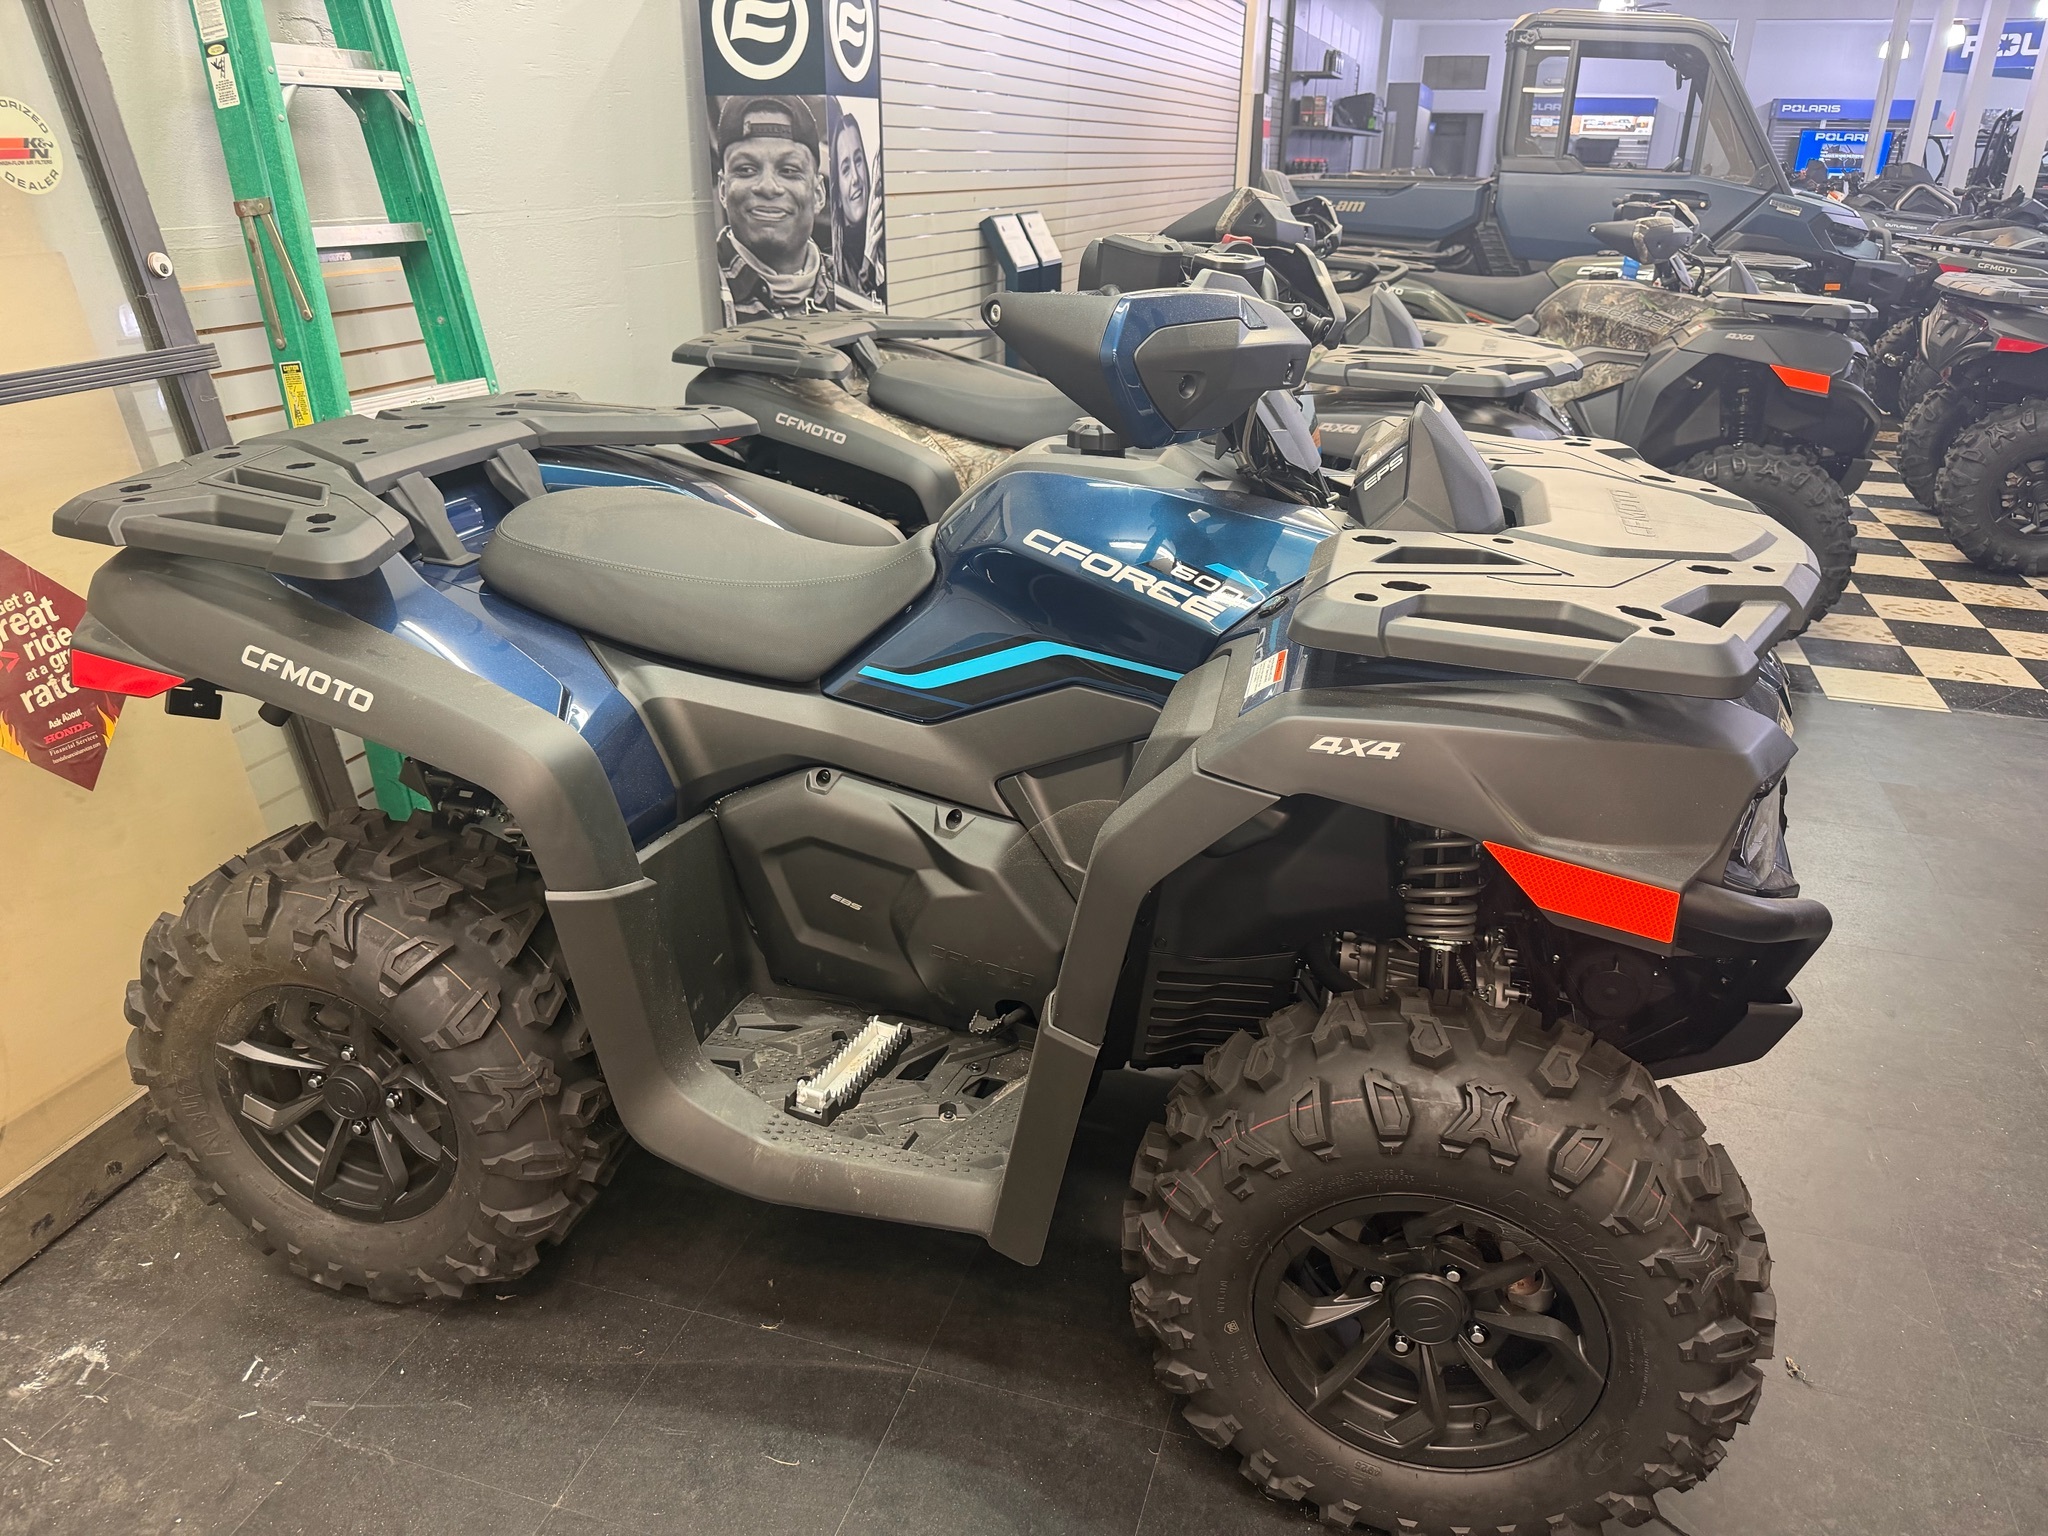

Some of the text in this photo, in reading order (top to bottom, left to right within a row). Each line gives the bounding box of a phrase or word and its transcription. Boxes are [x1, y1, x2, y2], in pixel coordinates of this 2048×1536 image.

[1781, 104, 1841, 114] POLARIS
[23, 137, 54, 159] K&N
[1815, 132, 1868, 142] POLARI
[5, 169, 59, 191] DEALER
[1978, 262, 2018, 274] CFMOTO
[775, 412, 847, 445] CFMOTO
[1363, 453, 1404, 492] EPS
[1022, 528, 1228, 621] CFORCE
[22, 590, 36, 605] a
[0, 595, 60, 650] reat
[22, 625, 73, 662] ride
[25, 666, 40, 682] at
[39, 664, 49, 675] a
[240, 644, 374, 713] CFMOTO
[48, 707, 82, 730] Ask About
[43, 720, 94, 745] HONDA
[49, 734, 99, 757] Financial Services
[1309, 736, 1401, 760] 4X4
[829, 893, 863, 911] EBS
